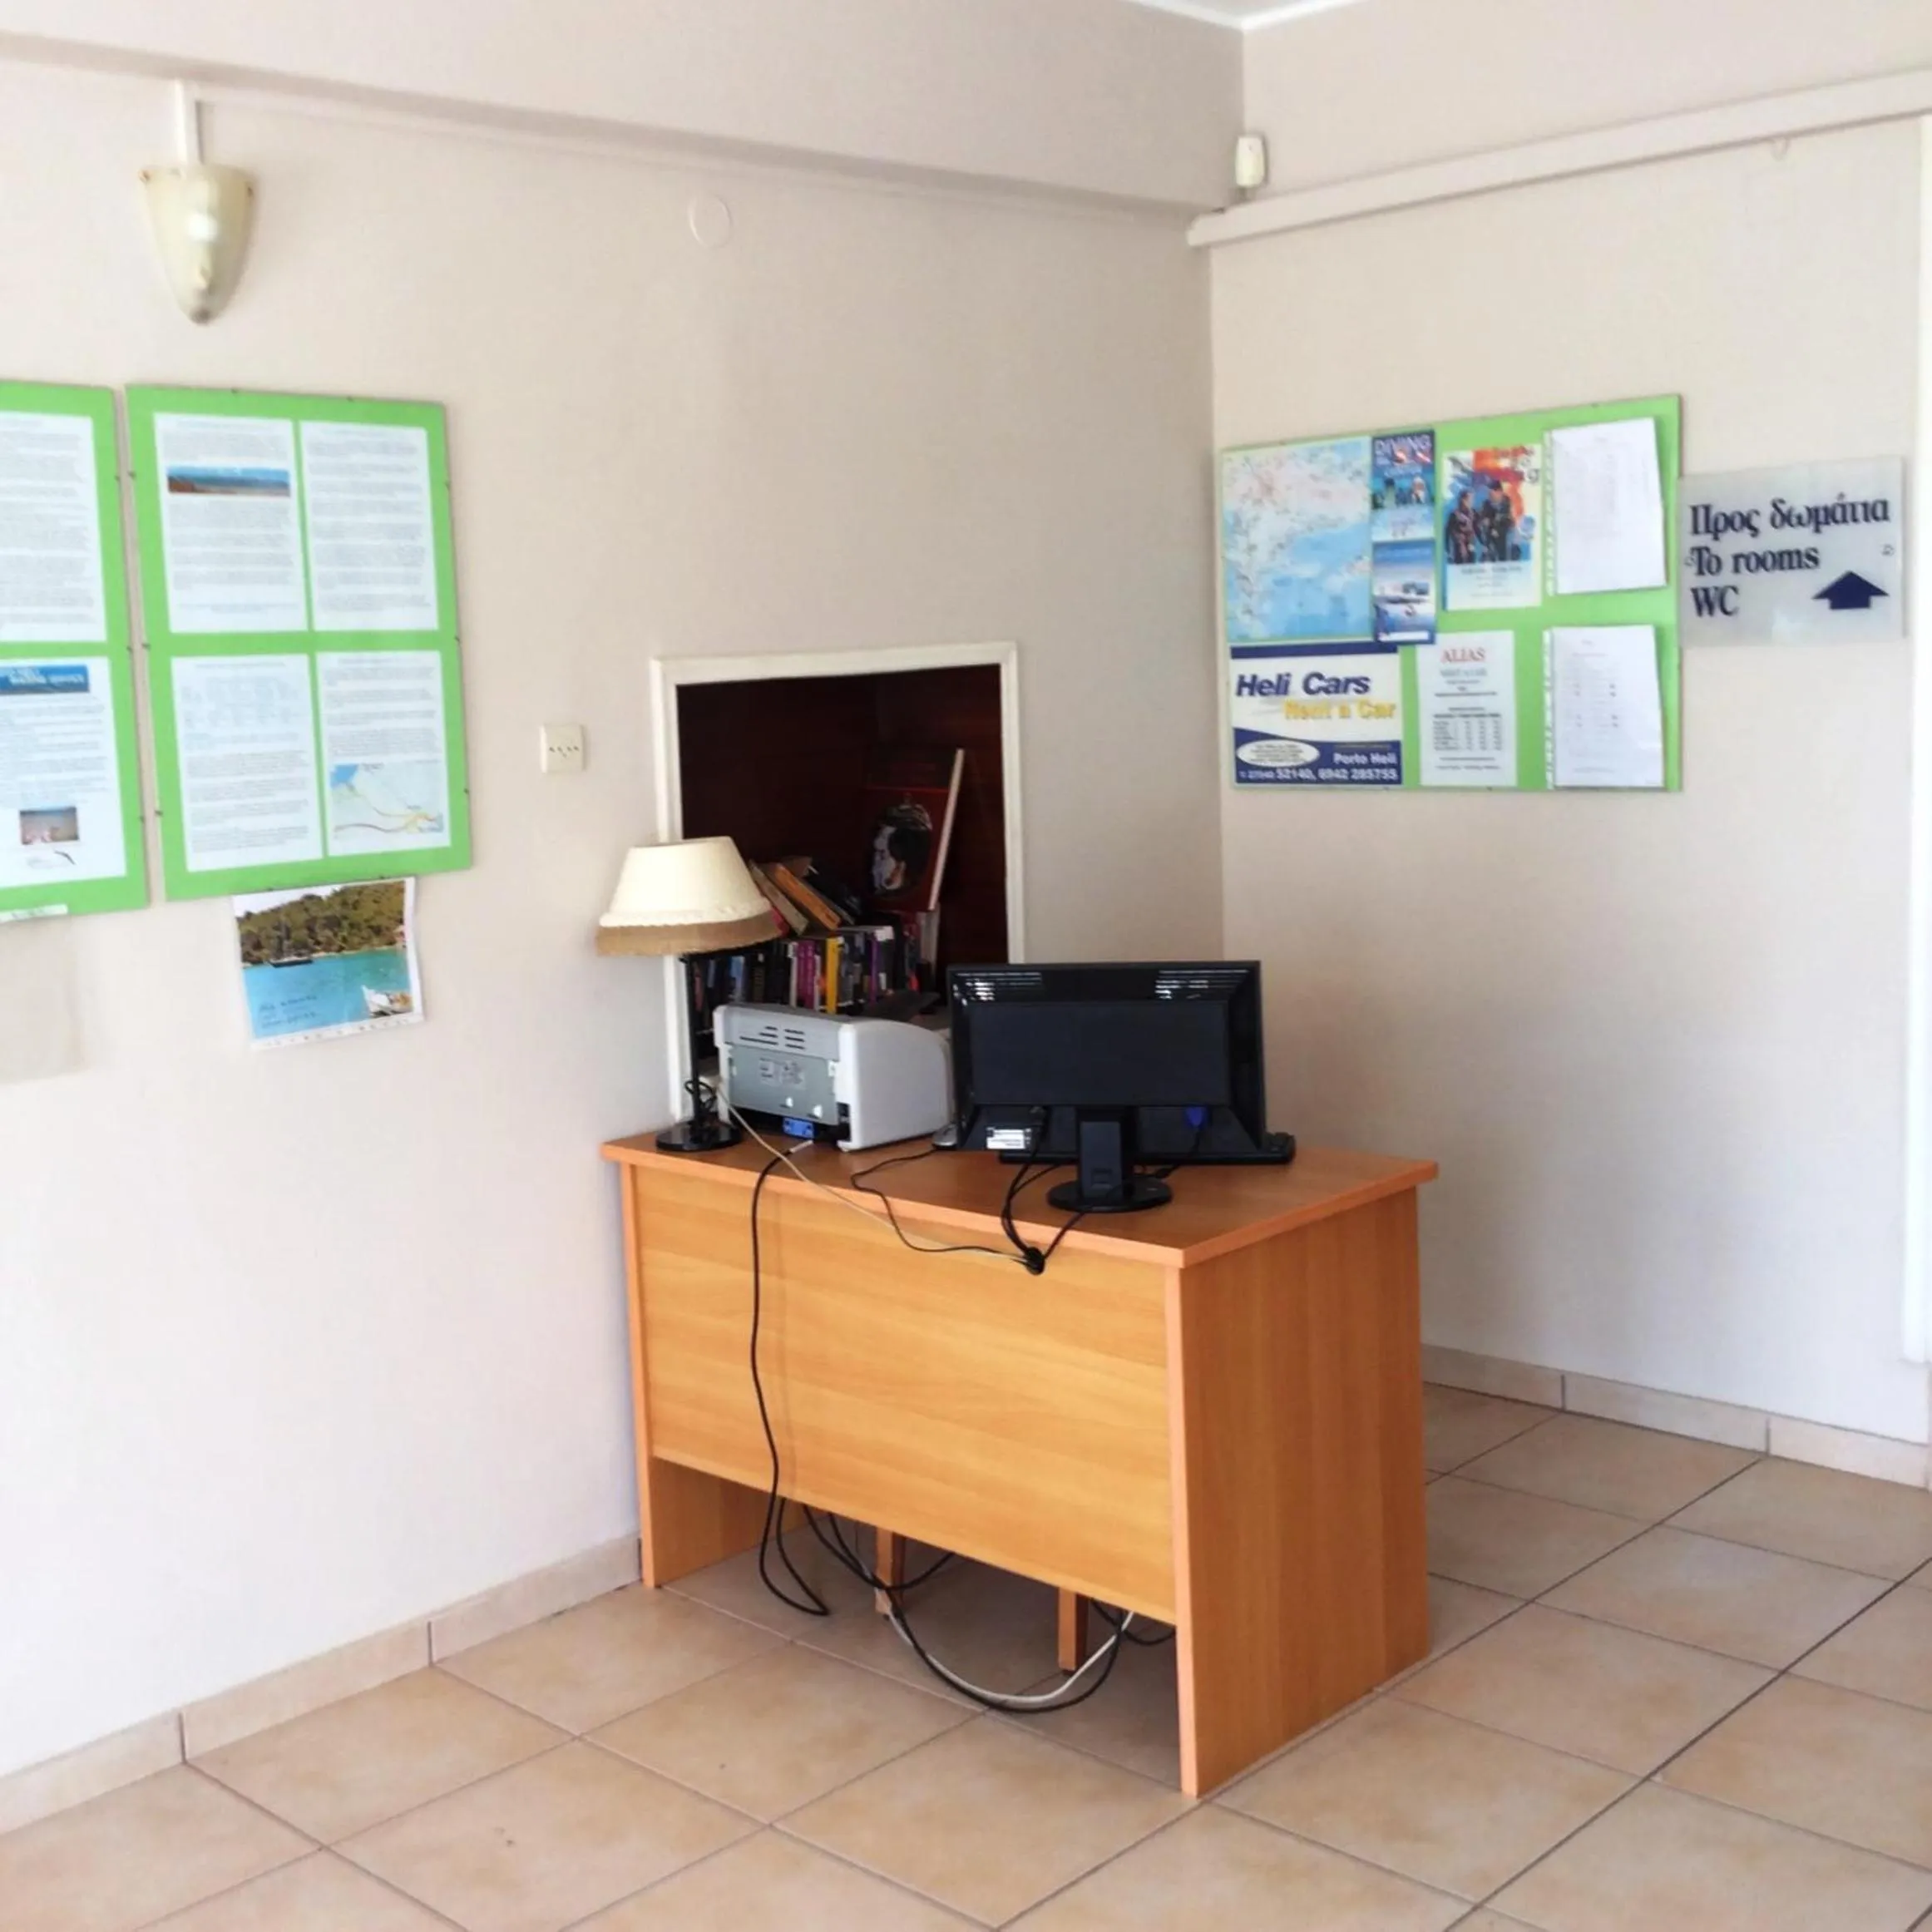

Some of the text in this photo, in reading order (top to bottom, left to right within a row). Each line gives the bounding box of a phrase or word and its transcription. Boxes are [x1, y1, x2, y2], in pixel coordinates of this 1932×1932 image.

[1690, 503, 1761, 541] Προς
[1691, 545, 1820, 576] To rooms
[1691, 586, 1739, 617] WC
[1440, 647, 1485, 664] ALIAS
[1236, 672, 1371, 696] Heli Cars
[1357, 699, 1396, 719] Car
[1333, 752, 1396, 764] Porto Heli
